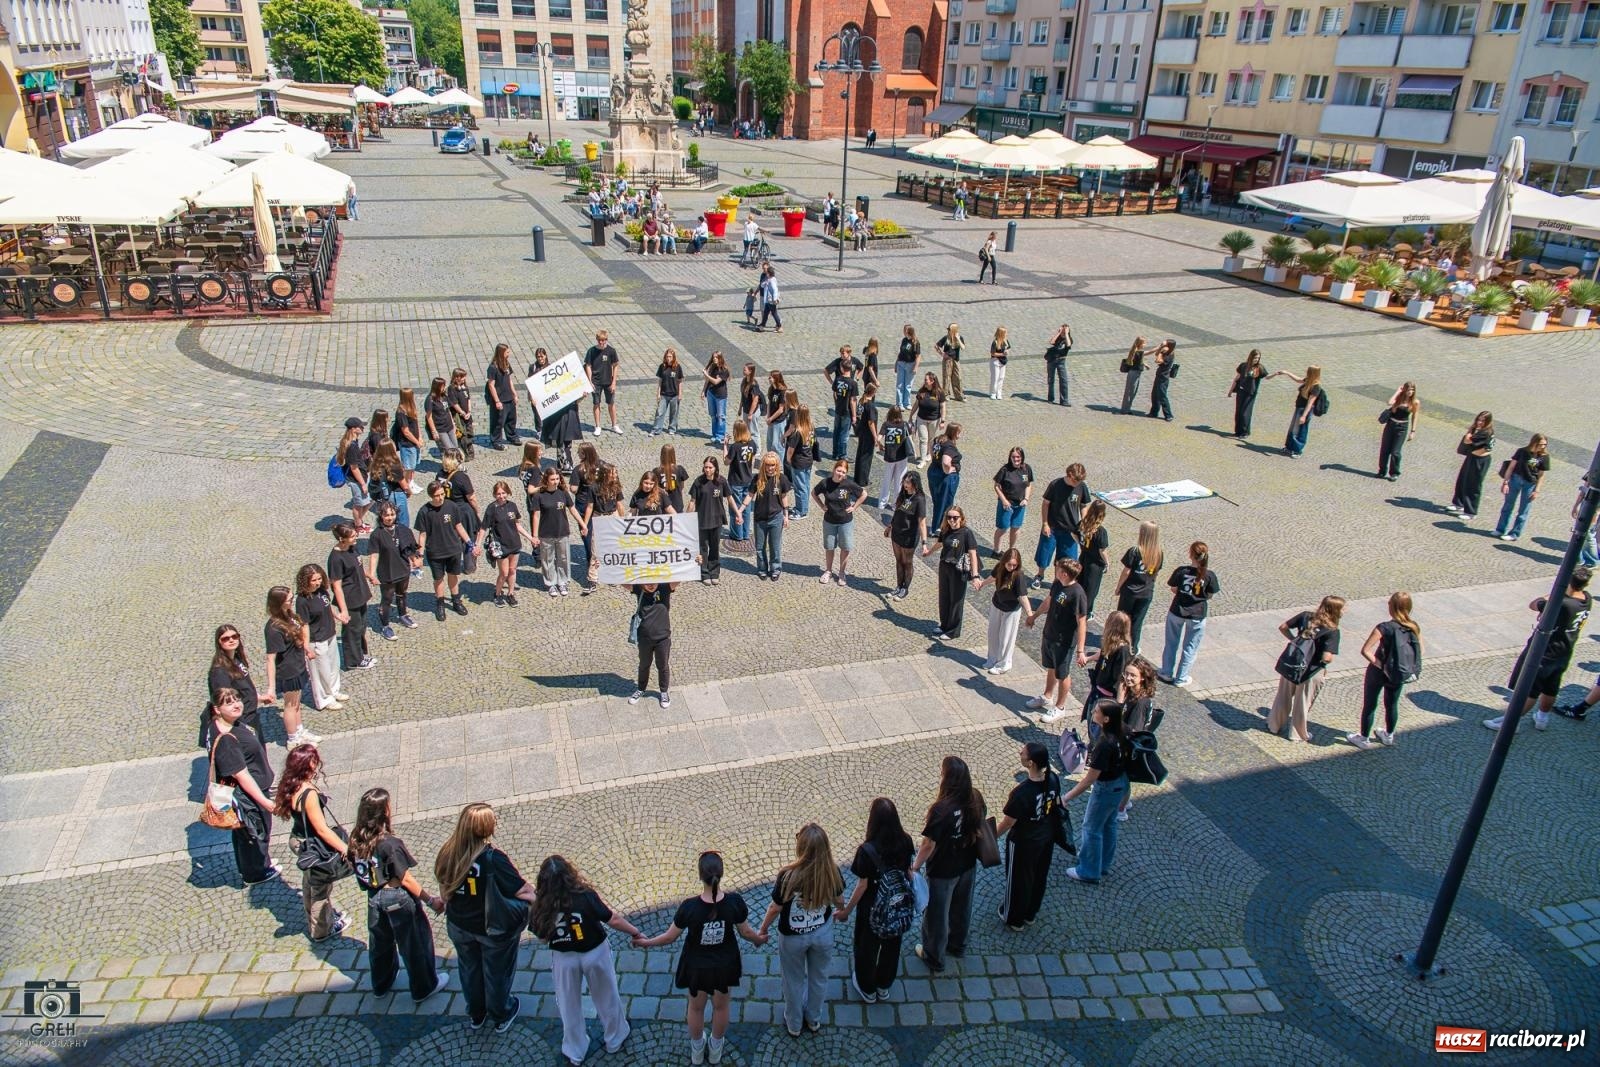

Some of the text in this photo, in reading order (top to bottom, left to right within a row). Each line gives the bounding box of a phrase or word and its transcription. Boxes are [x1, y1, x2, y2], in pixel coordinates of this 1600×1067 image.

[1415, 160, 1450, 175] empik
[56, 215, 82, 223] TYSKIE
[1537, 219, 1572, 232] gelatopiu
[542, 361, 569, 385] ZSO1
[623, 516, 674, 536] ZSO1
[603, 552, 638, 566] GDZIE
[646, 547, 692, 565] JESTEŚ
